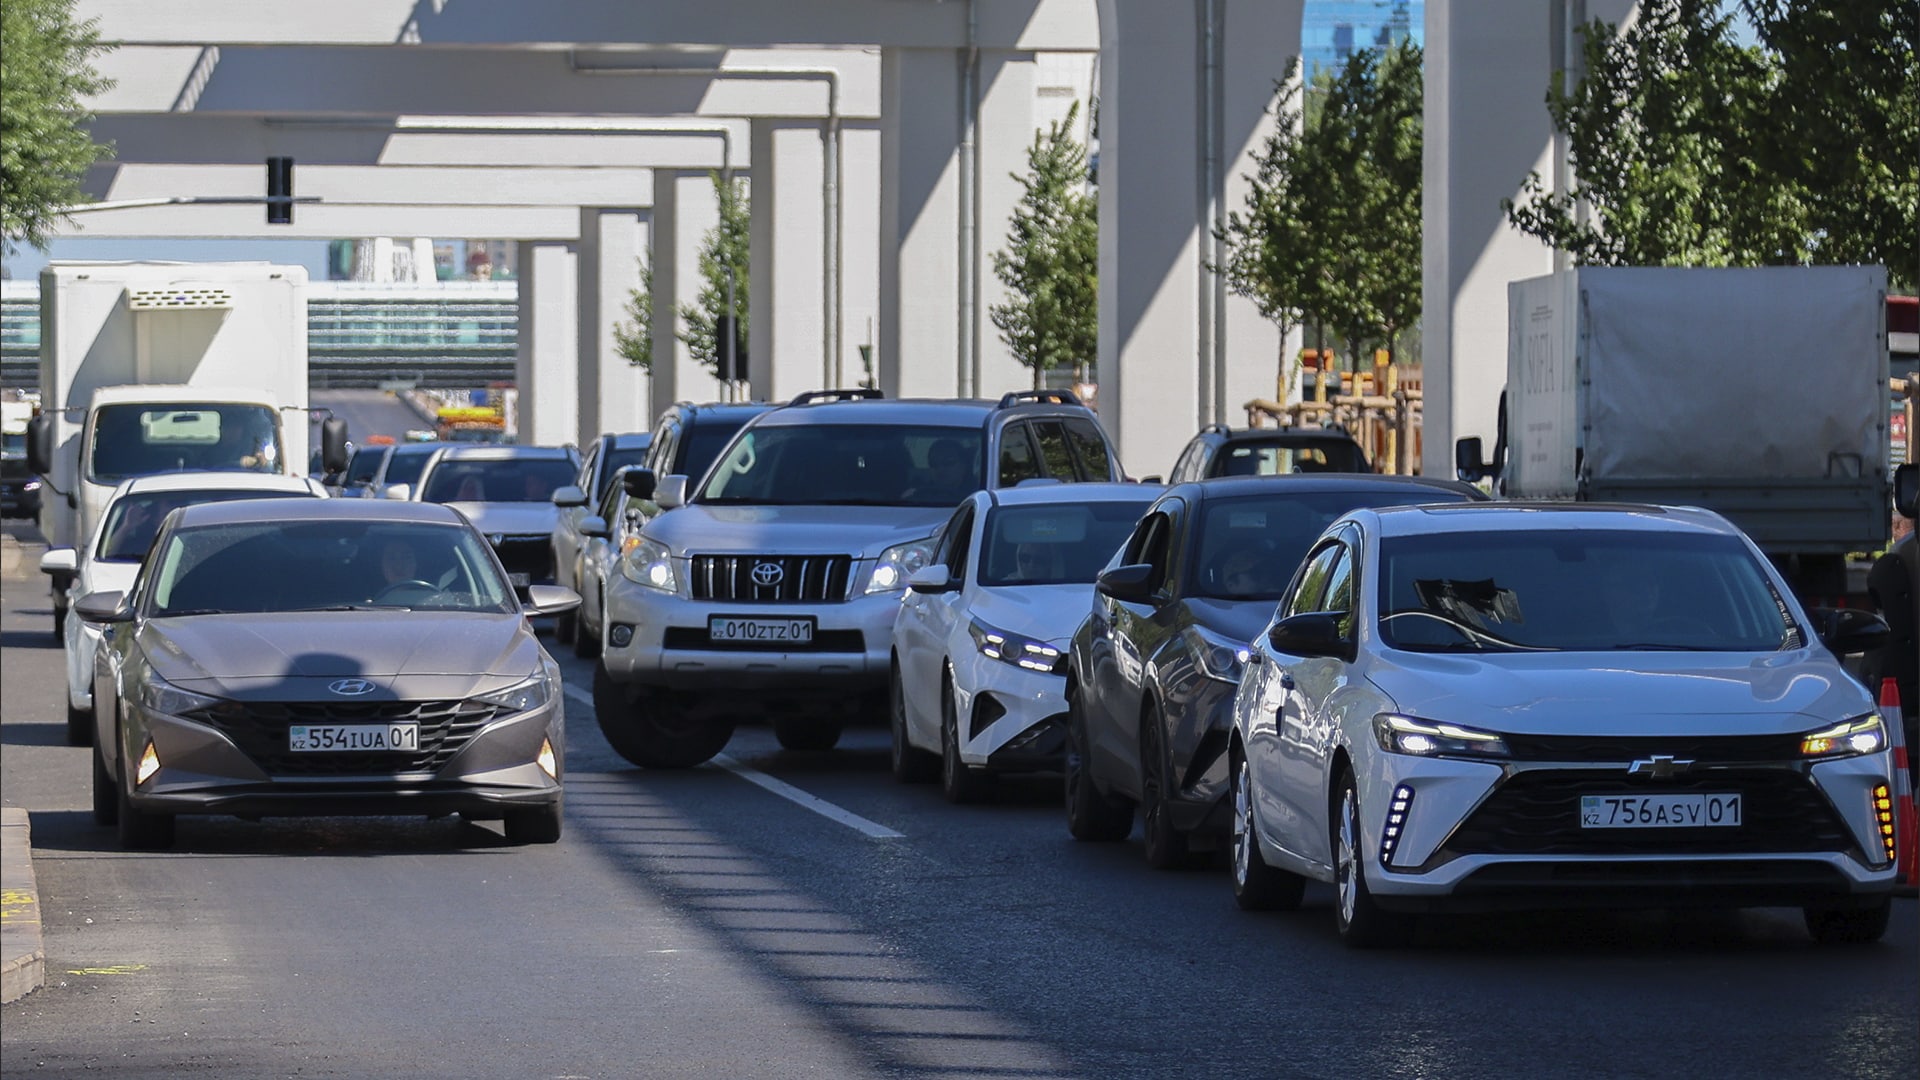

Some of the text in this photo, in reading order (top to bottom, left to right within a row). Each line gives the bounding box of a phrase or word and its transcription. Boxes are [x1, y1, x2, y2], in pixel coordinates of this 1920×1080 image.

[727, 621, 787, 639] 010ZTZ
[791, 622, 811, 640] 01
[292, 727, 415, 749] KZ 554IUA 01
[1583, 798, 1739, 825] KZ 756ASV 01
